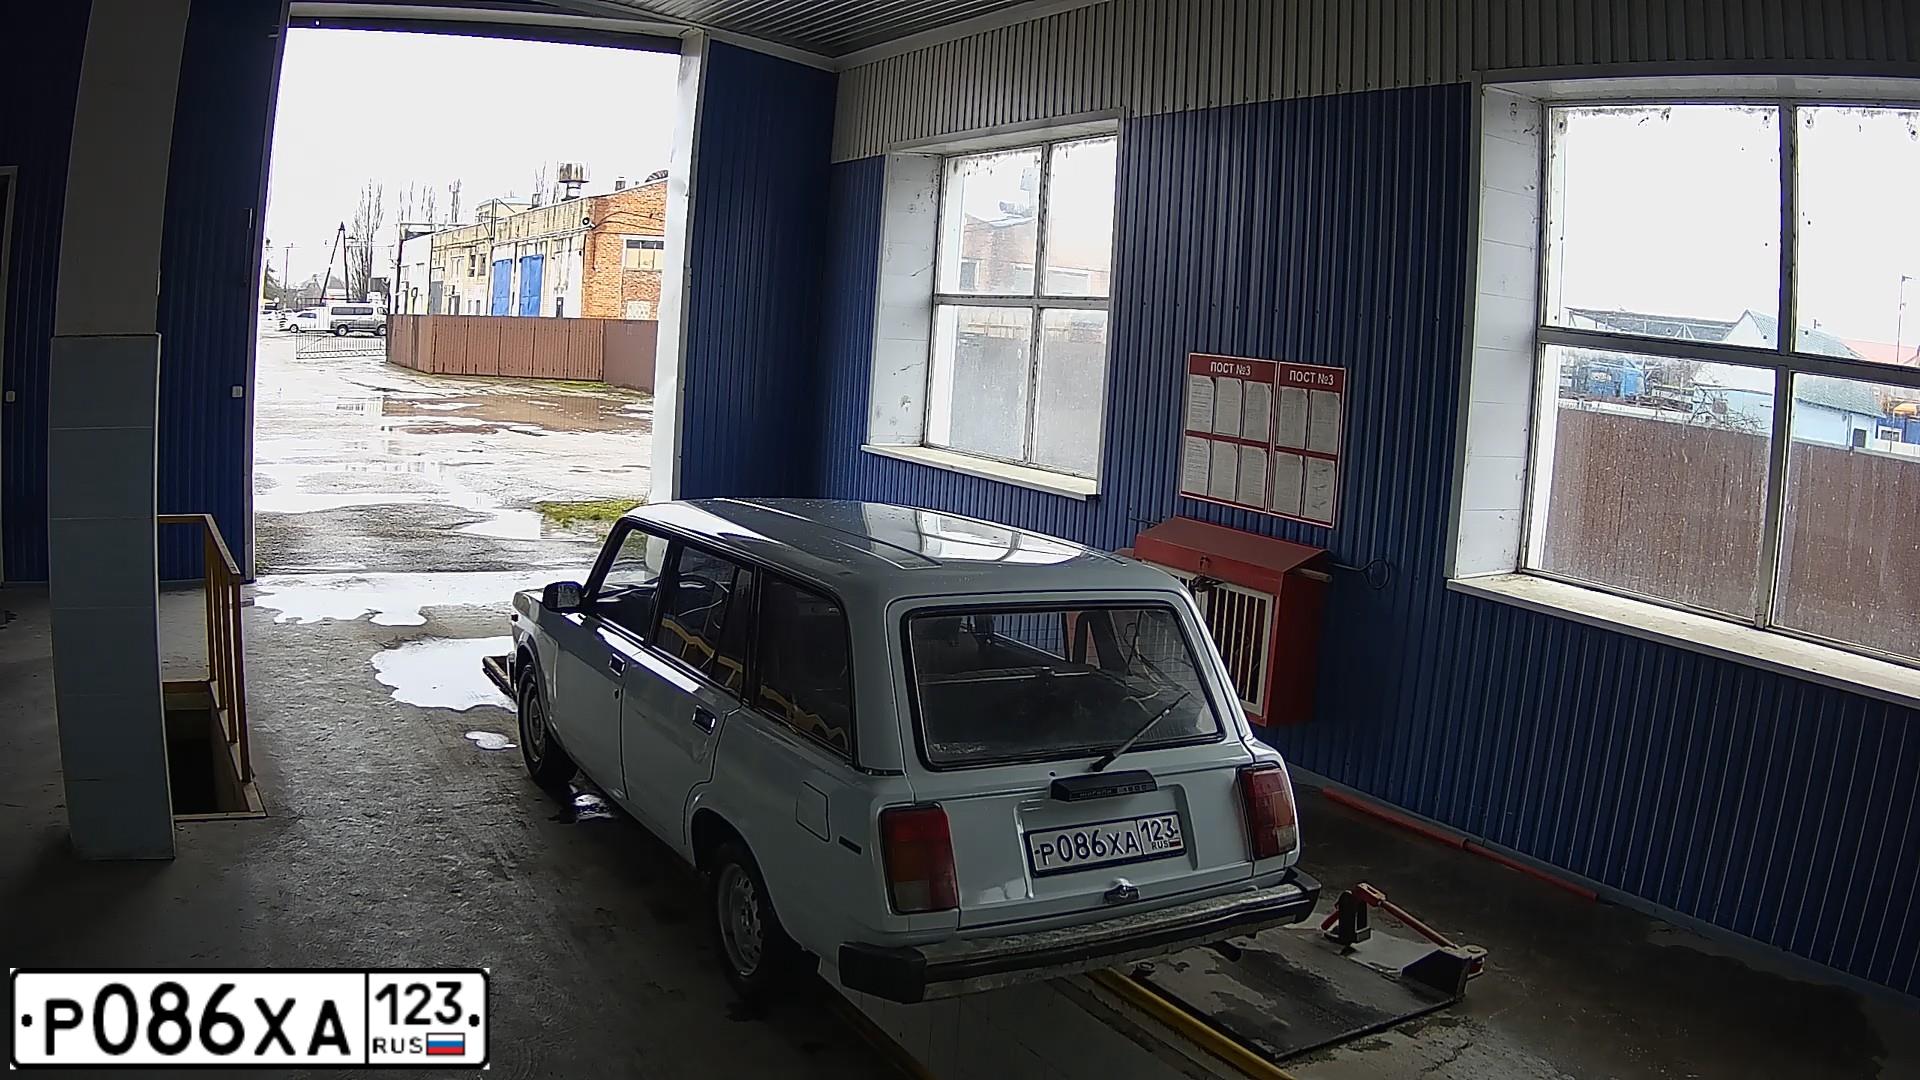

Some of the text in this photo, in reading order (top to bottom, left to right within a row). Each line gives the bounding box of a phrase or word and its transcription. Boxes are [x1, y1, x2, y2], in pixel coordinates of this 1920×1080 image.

[1210, 361, 1251, 376] ПОСТ №3
[1289, 370, 1334, 386] ПОСТ №3
[1039, 818, 1174, 866] Р086ХА 123
[1151, 839, 1170, 850] RUS
